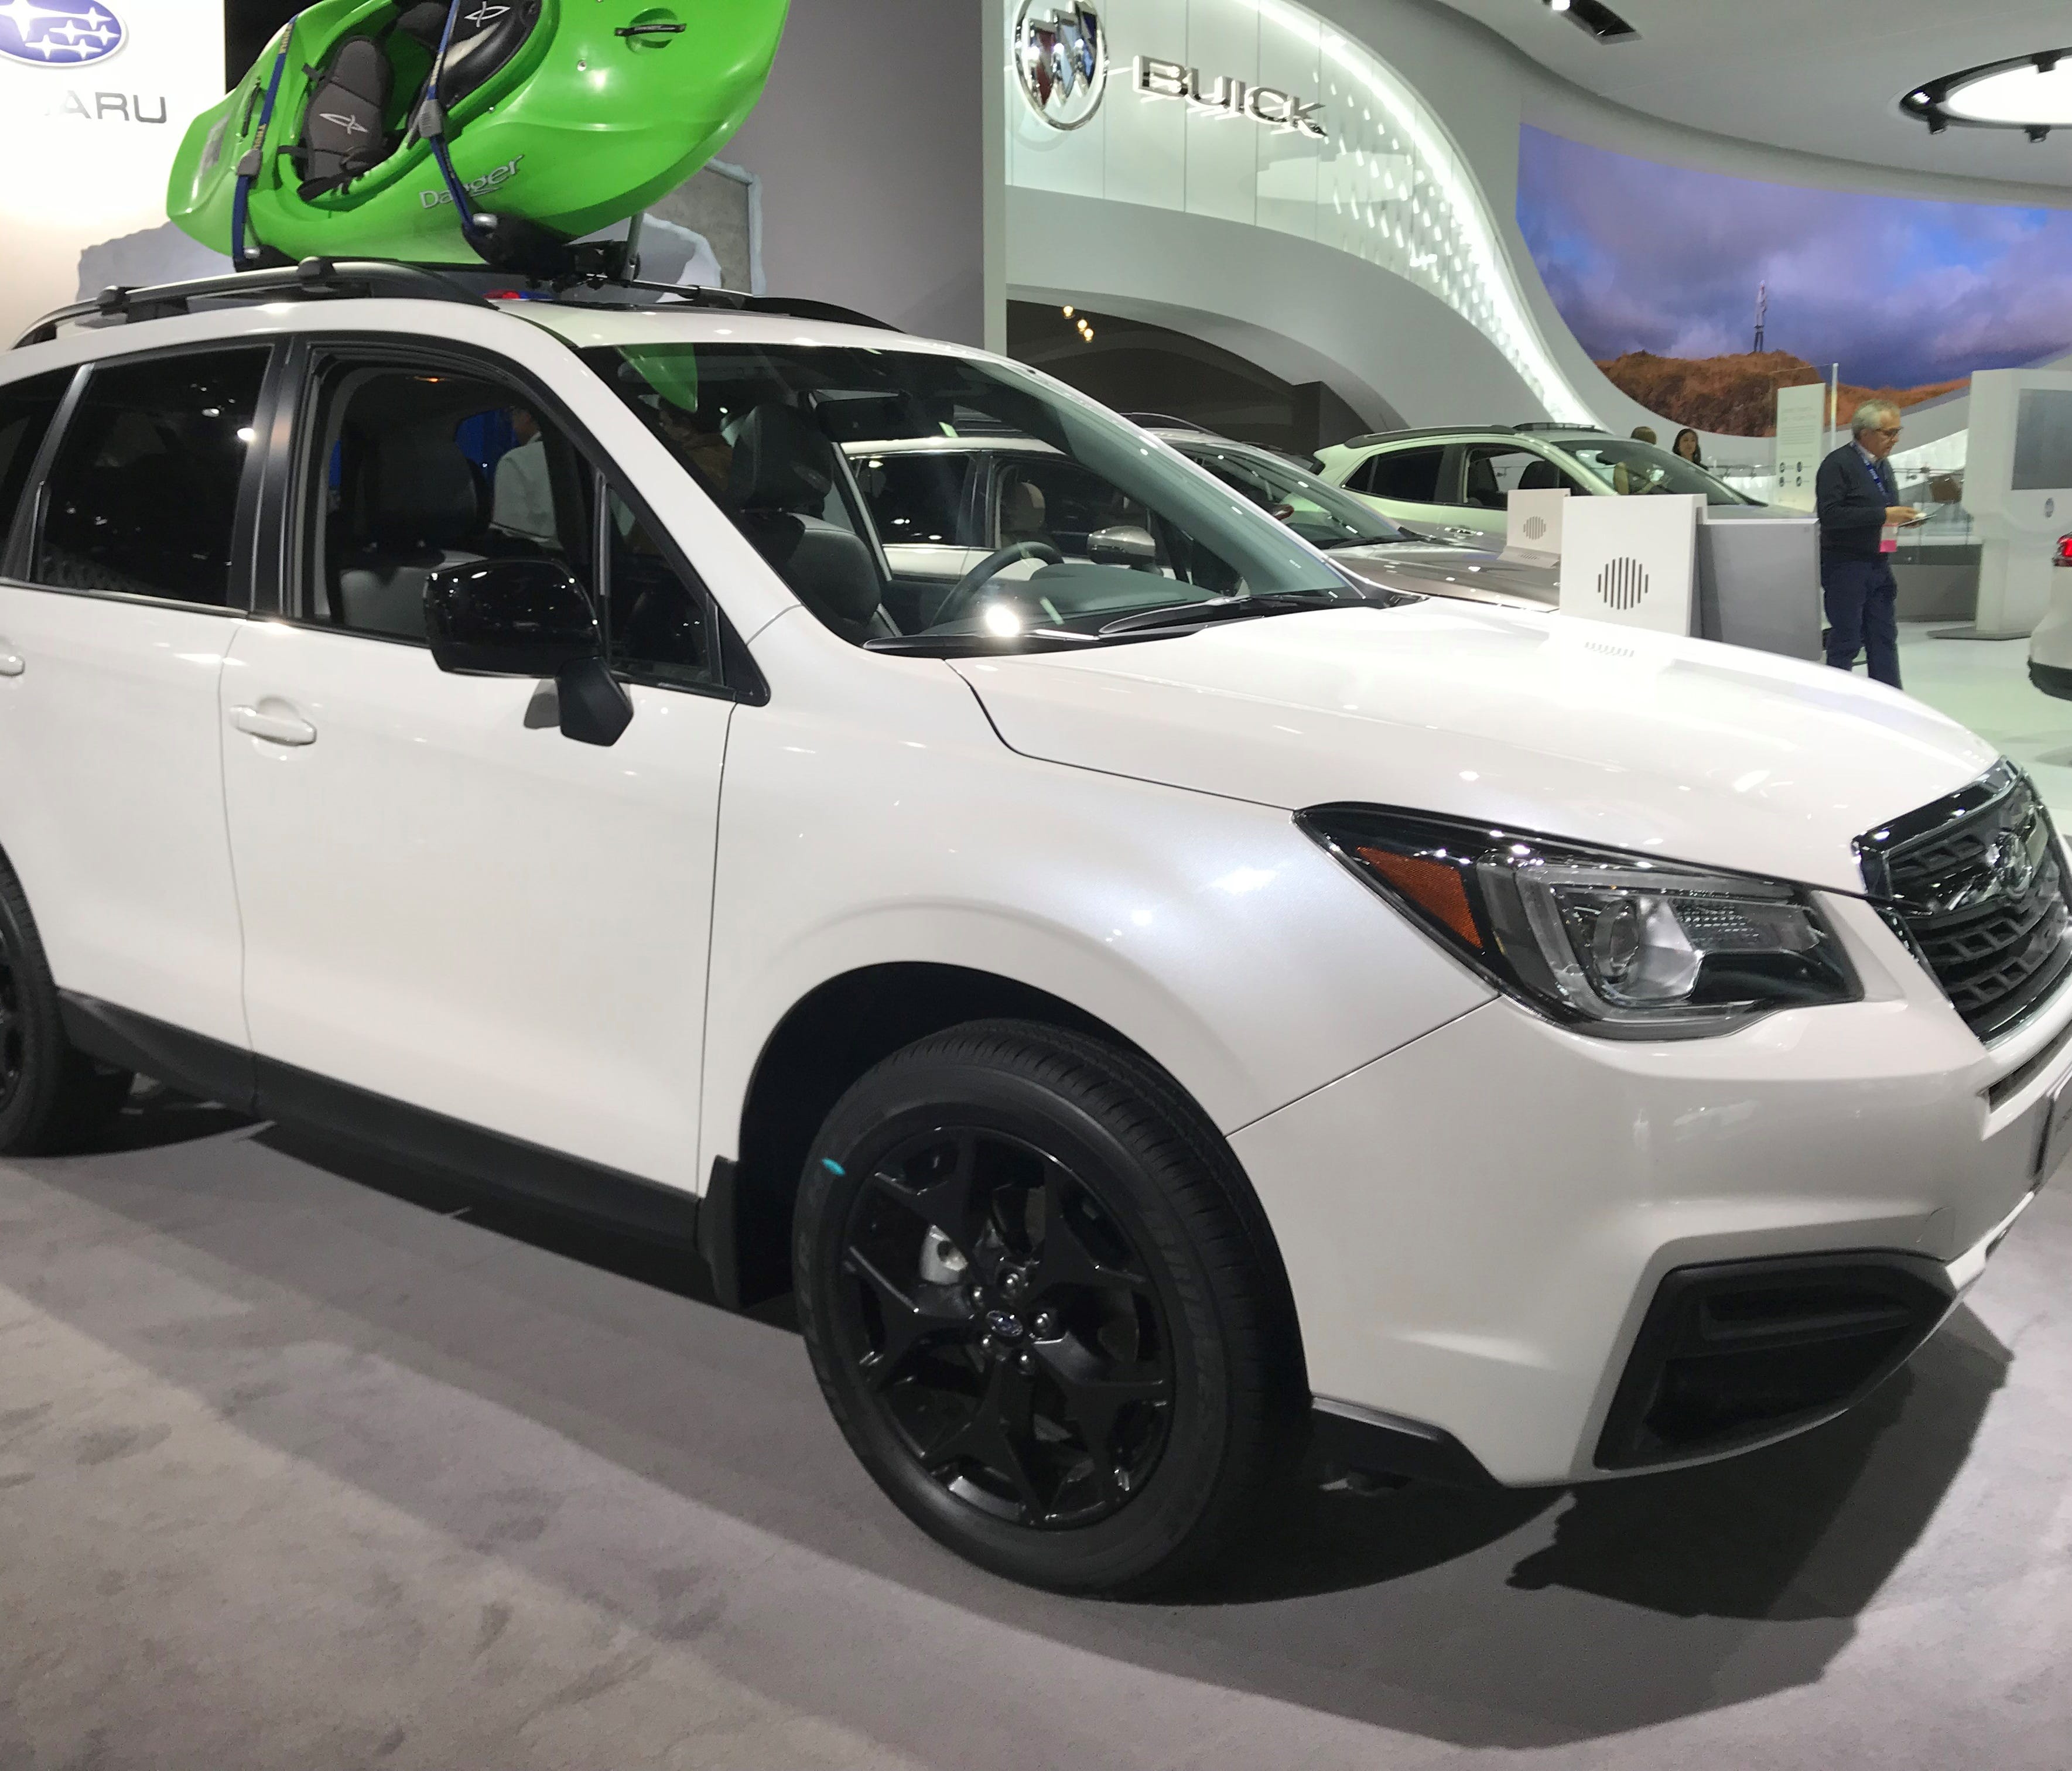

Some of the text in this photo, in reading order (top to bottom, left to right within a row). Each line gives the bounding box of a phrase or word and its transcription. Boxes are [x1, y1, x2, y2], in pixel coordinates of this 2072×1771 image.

[44, 89, 167, 125] ARU
[1132, 55, 1327, 138] BUICK
[419, 154, 525, 210] Dager
